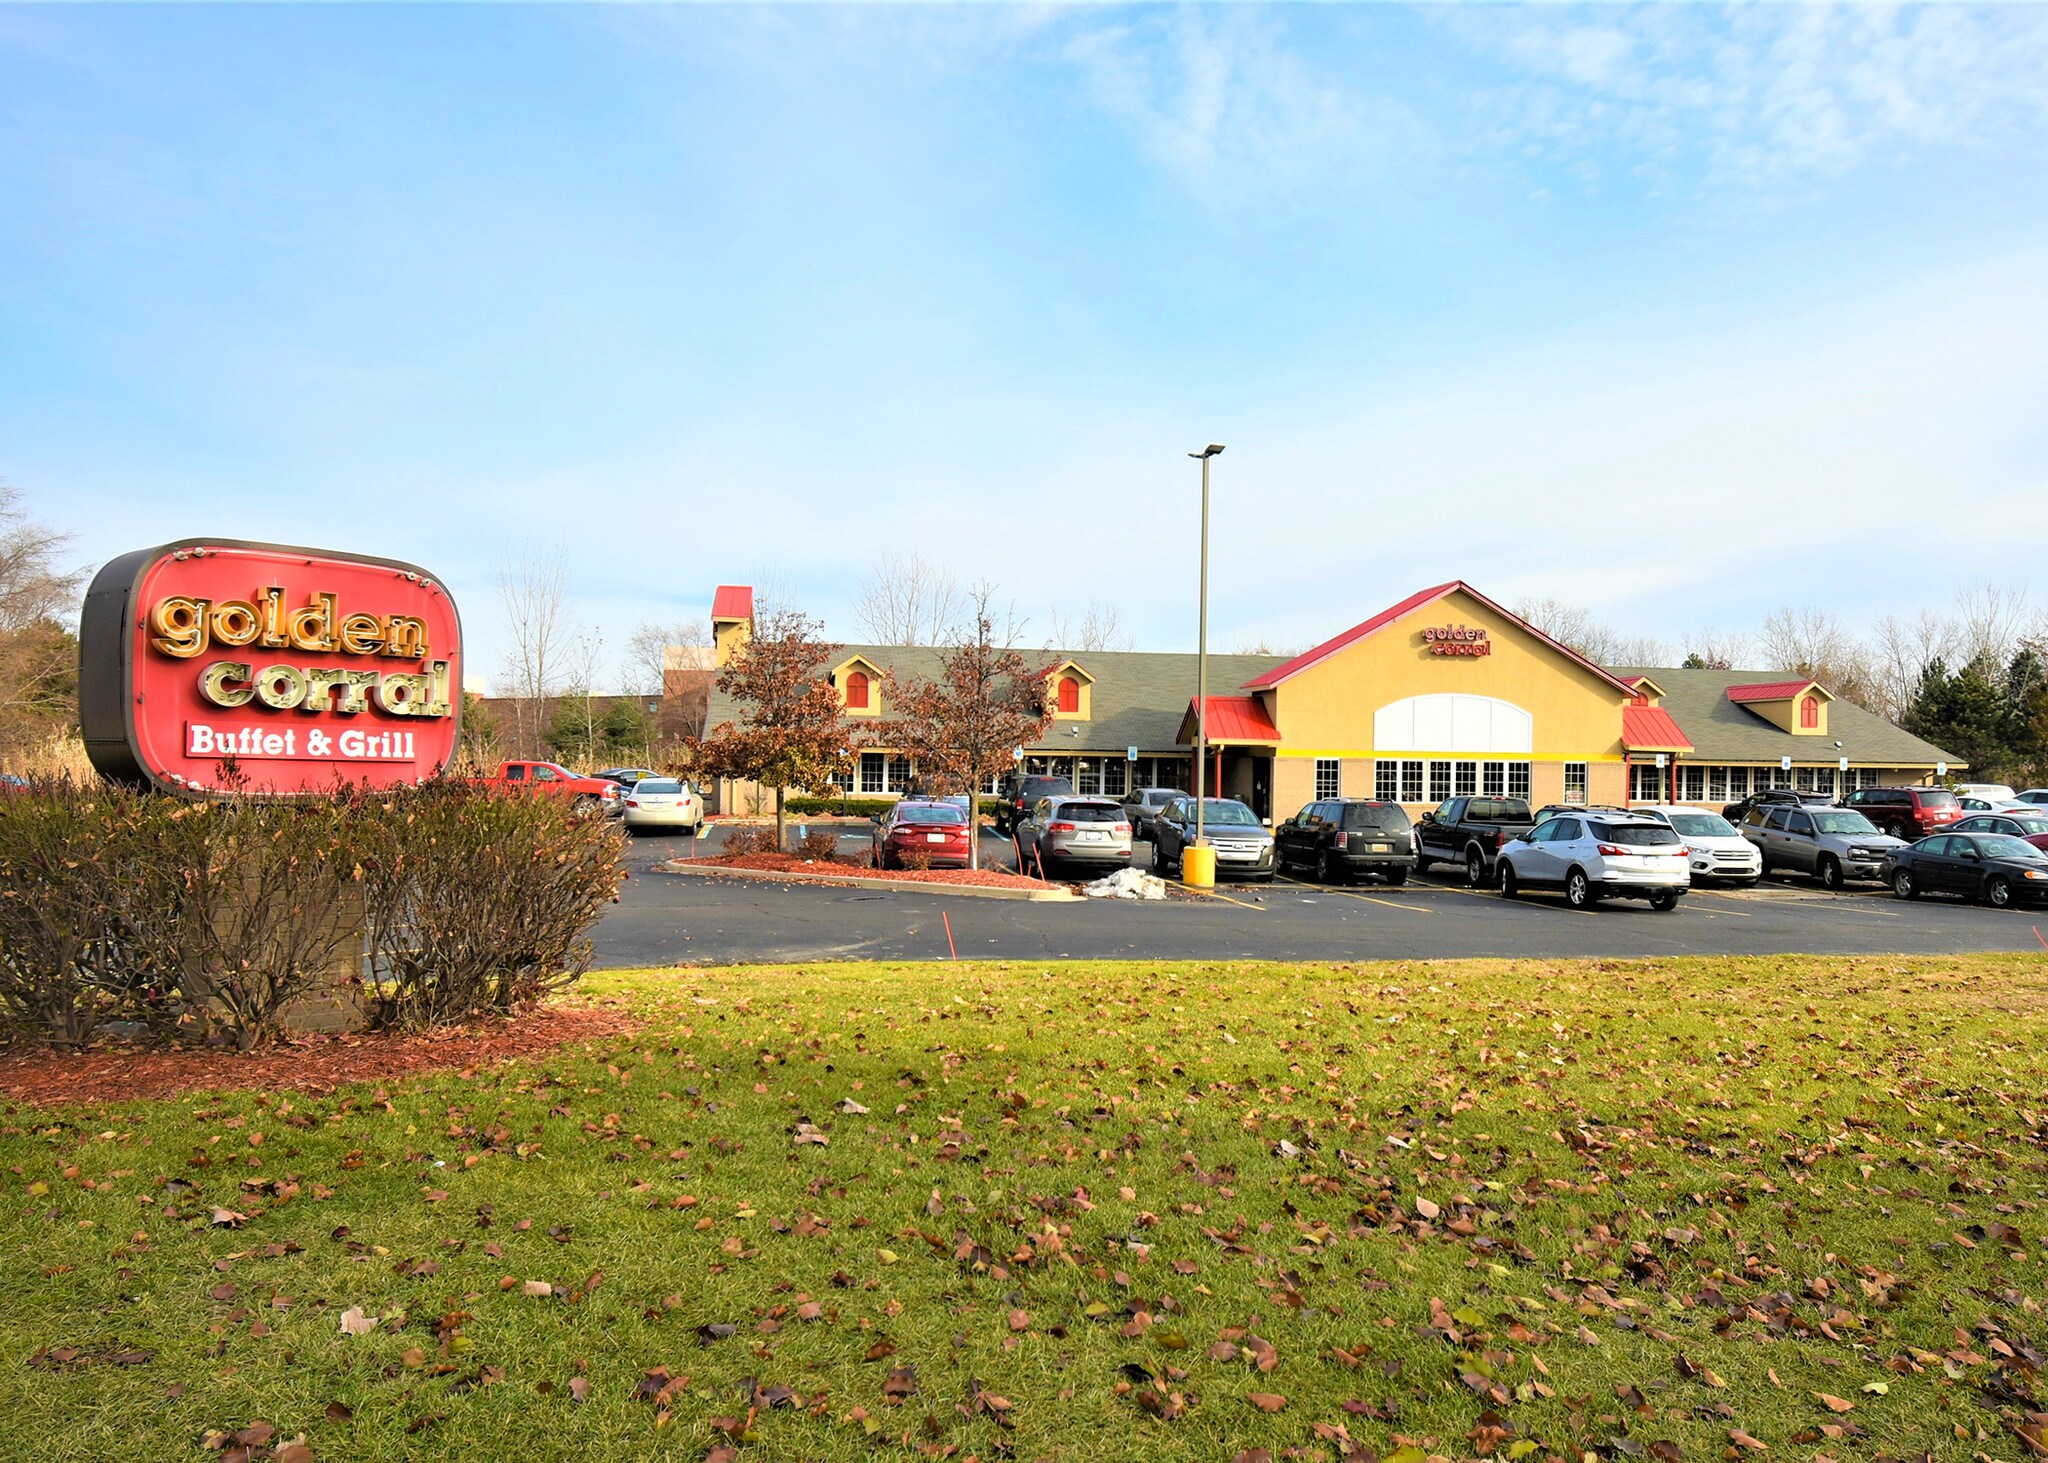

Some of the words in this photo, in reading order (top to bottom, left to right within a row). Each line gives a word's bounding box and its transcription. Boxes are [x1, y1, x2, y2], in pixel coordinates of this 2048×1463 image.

[152, 587, 431, 658] golden
[1424, 624, 1487, 643] golden
[1432, 641, 1491, 657] corral
[198, 659, 453, 716] corral
[191, 724, 296, 756] Buffet
[307, 728, 332, 757] &
[339, 729, 415, 759] Grill
